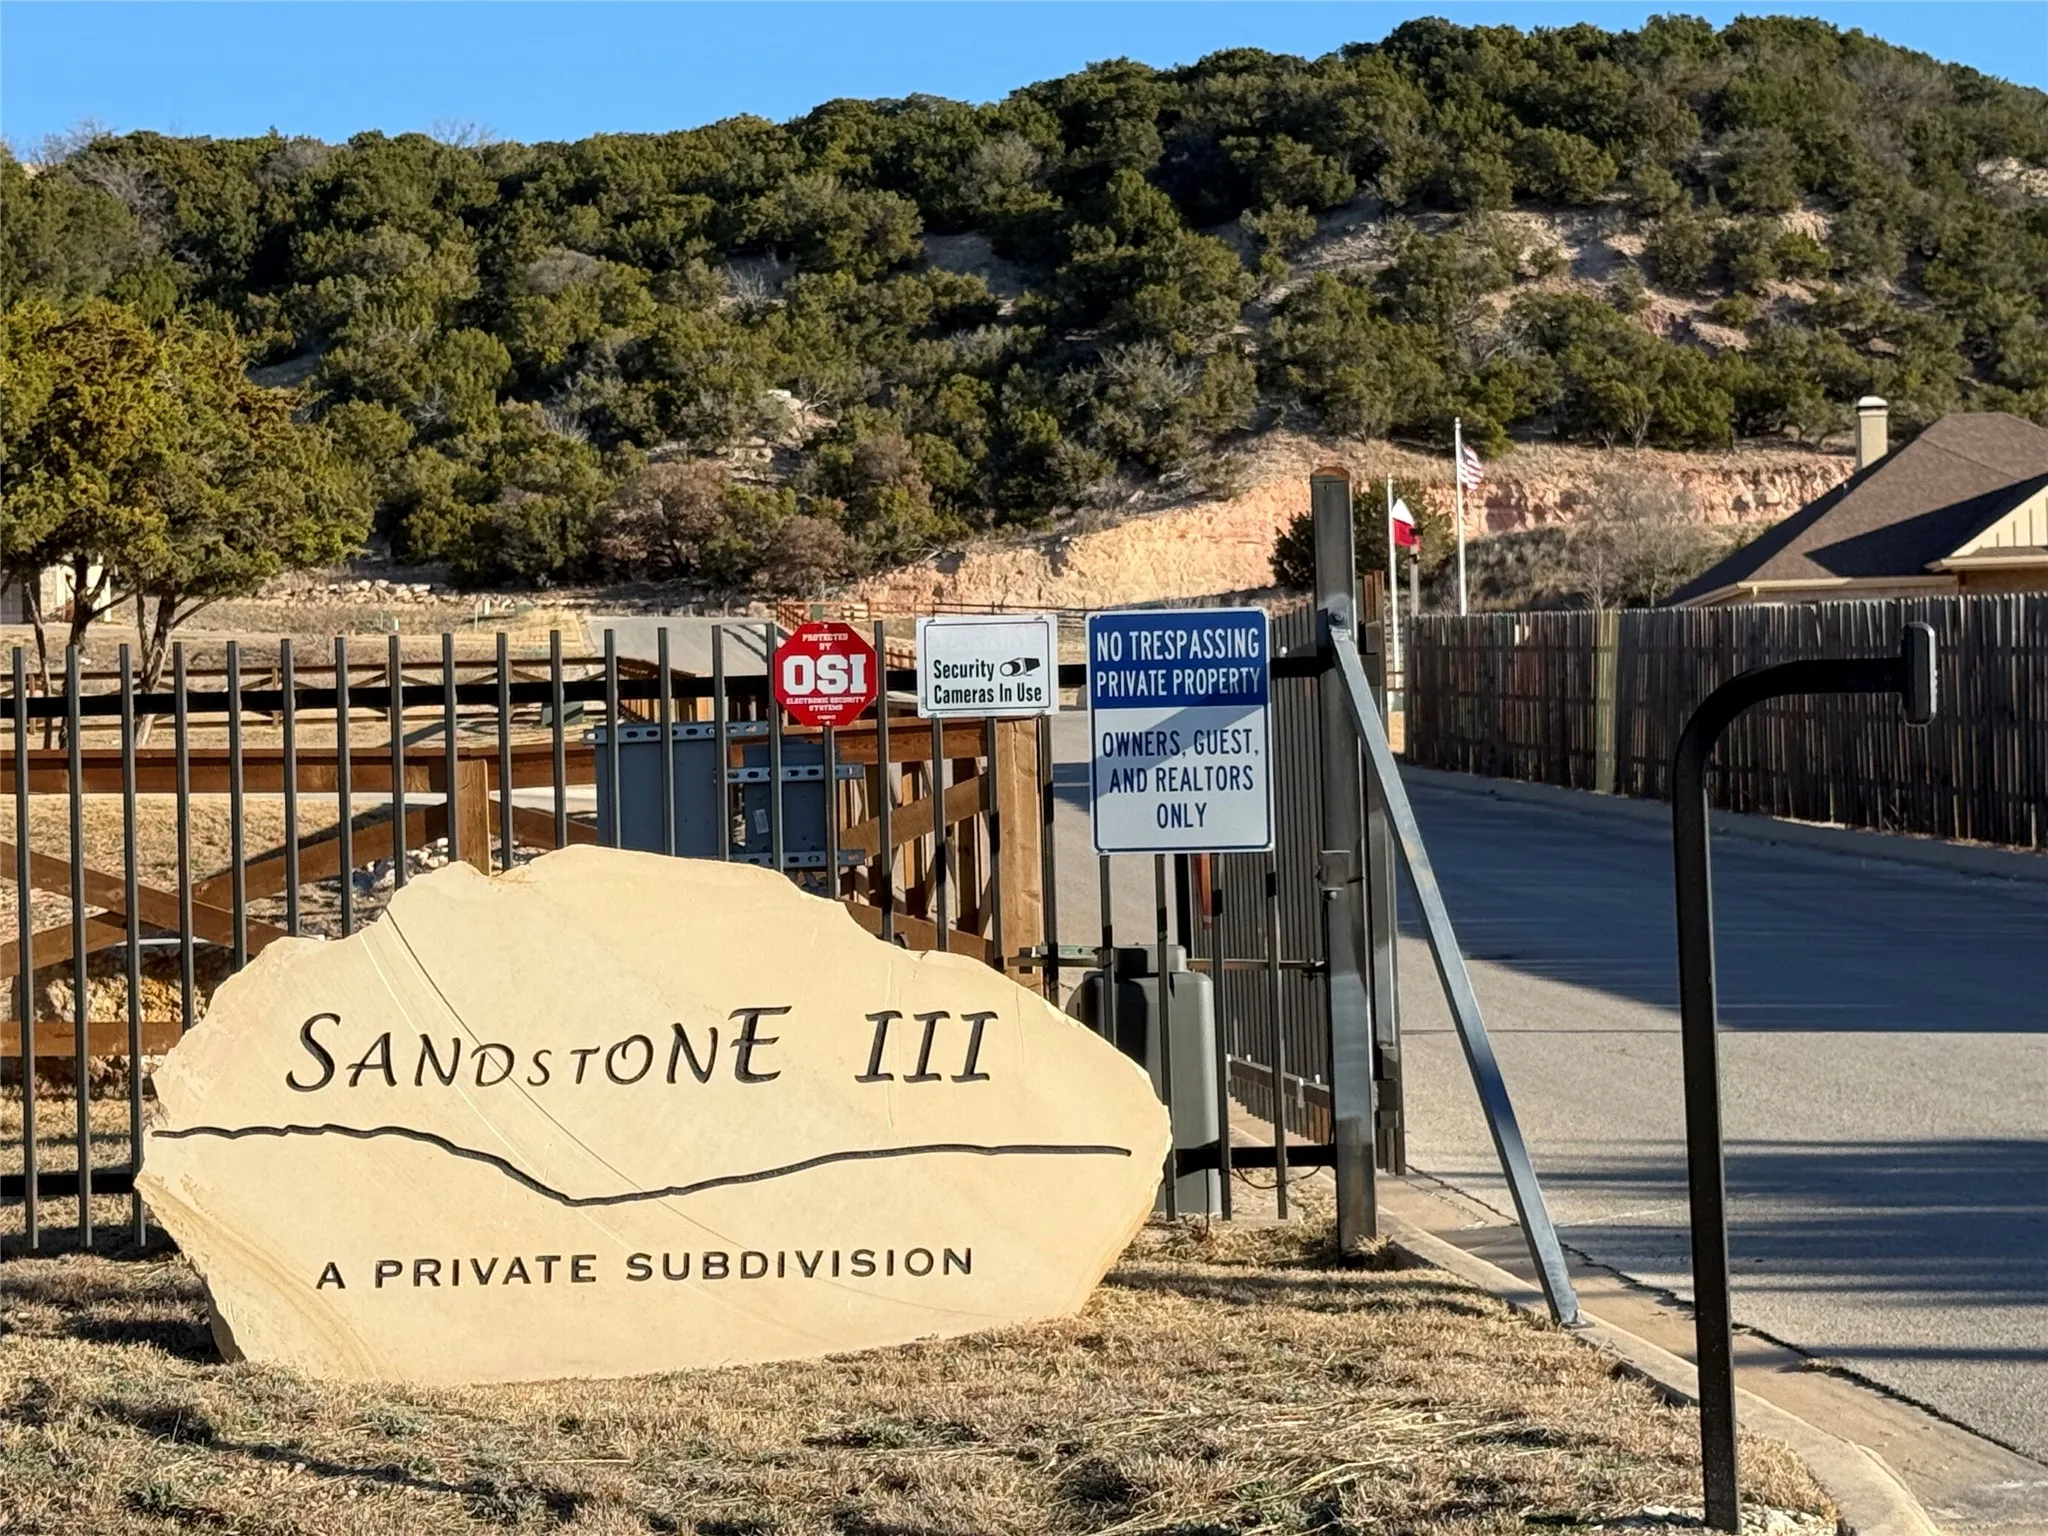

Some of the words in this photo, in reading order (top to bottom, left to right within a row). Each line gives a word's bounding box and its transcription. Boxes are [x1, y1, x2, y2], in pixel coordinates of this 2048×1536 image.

[802, 633, 848, 642] PROTECTED
[819, 642, 832, 651] BY
[1096, 630, 1122, 662] NO
[1129, 628, 1260, 661] TRESPASSING
[783, 653, 867, 695] OSI
[933, 658, 995, 682] Security
[1096, 668, 1167, 697] PRIVATE
[1173, 667, 1261, 696] PROPERTY
[934, 684, 995, 704] Cameras
[1000, 683, 1012, 703] In
[1017, 682, 1042, 702] Use
[1102, 730, 1187, 759] OWNERS,
[1194, 728, 1260, 757] GUEST,
[1109, 767, 1148, 794] AND
[1156, 765, 1254, 793] REALTORS
[1156, 802, 1208, 829] ONLY
[285, 1005, 793, 1092] SANDSTONE
[854, 1010, 1000, 1085] III
[315, 1261, 346, 1290] A
[375, 1254, 598, 1289] PRIVATE
[625, 1247, 973, 1283] SUBDIVISION
